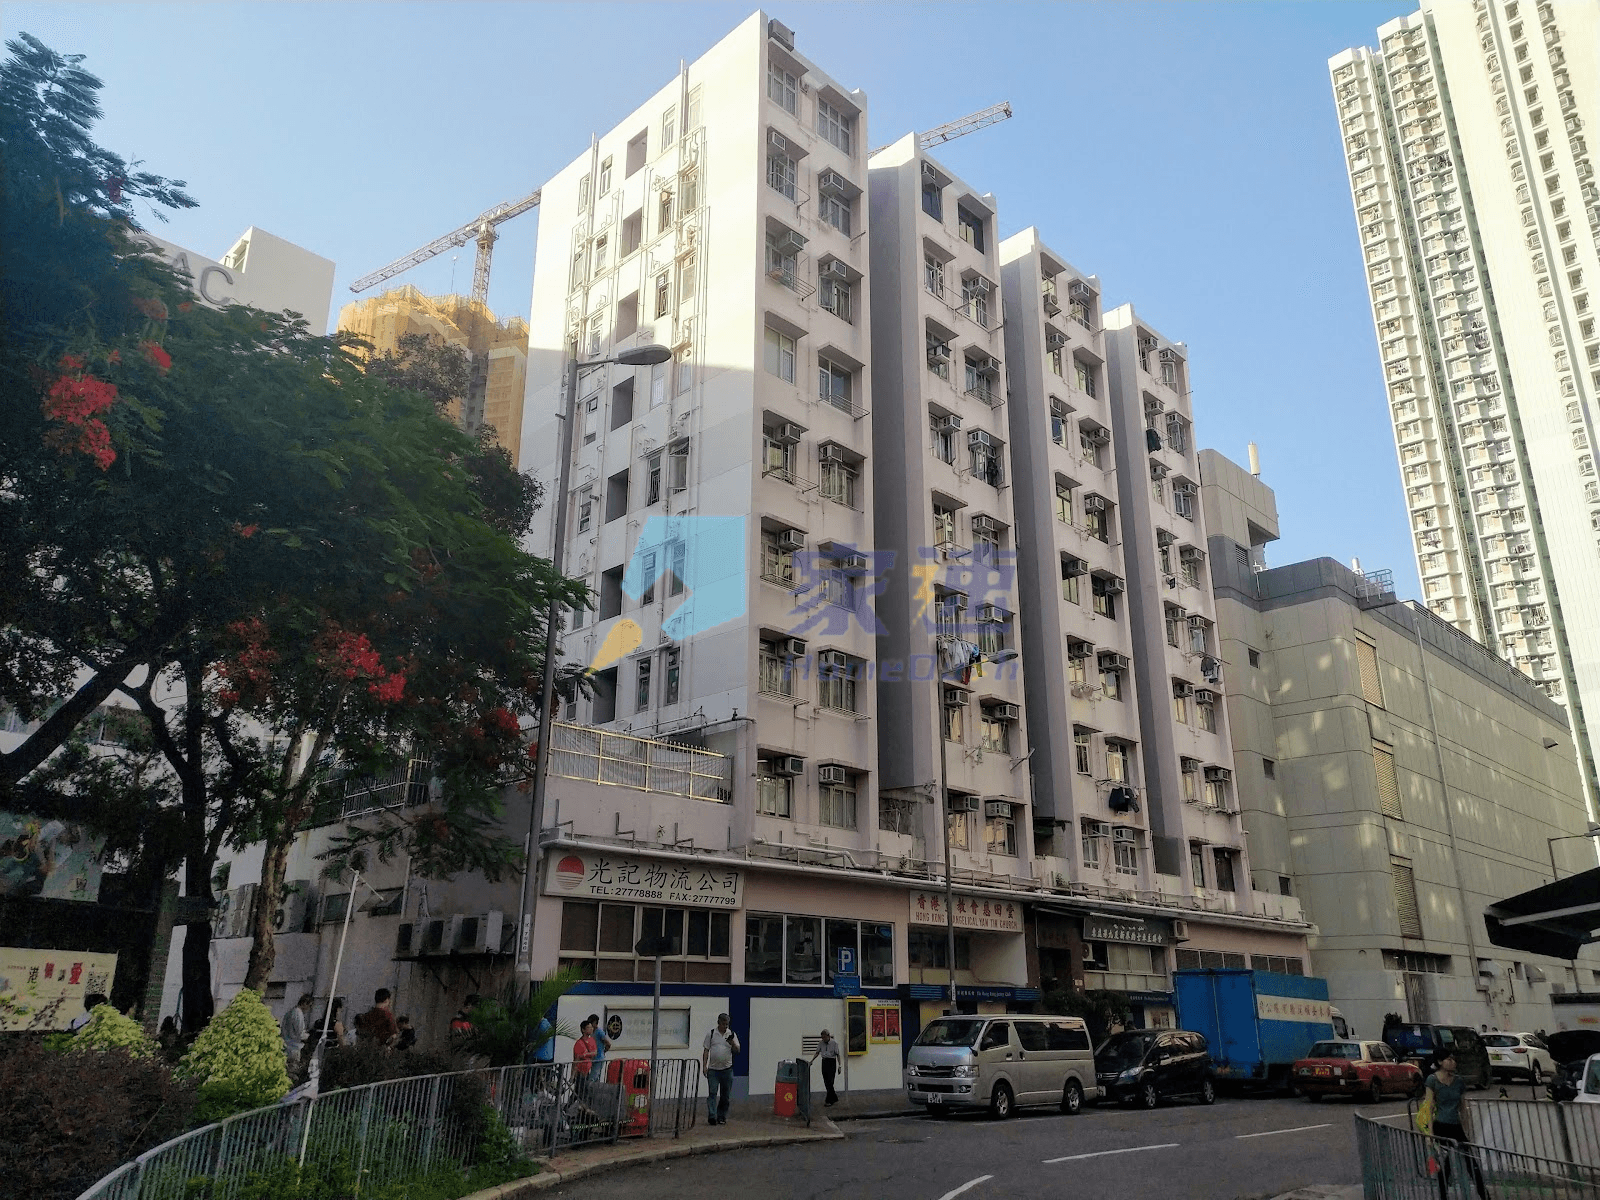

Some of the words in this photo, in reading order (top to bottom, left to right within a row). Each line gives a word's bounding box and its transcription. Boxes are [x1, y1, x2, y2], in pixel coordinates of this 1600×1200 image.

[587, 858, 739, 895] 光記物流公司
[589, 885, 663, 899] TEL:27778888
[915, 911, 930, 922] HONG
[841, 950, 852, 971] P
